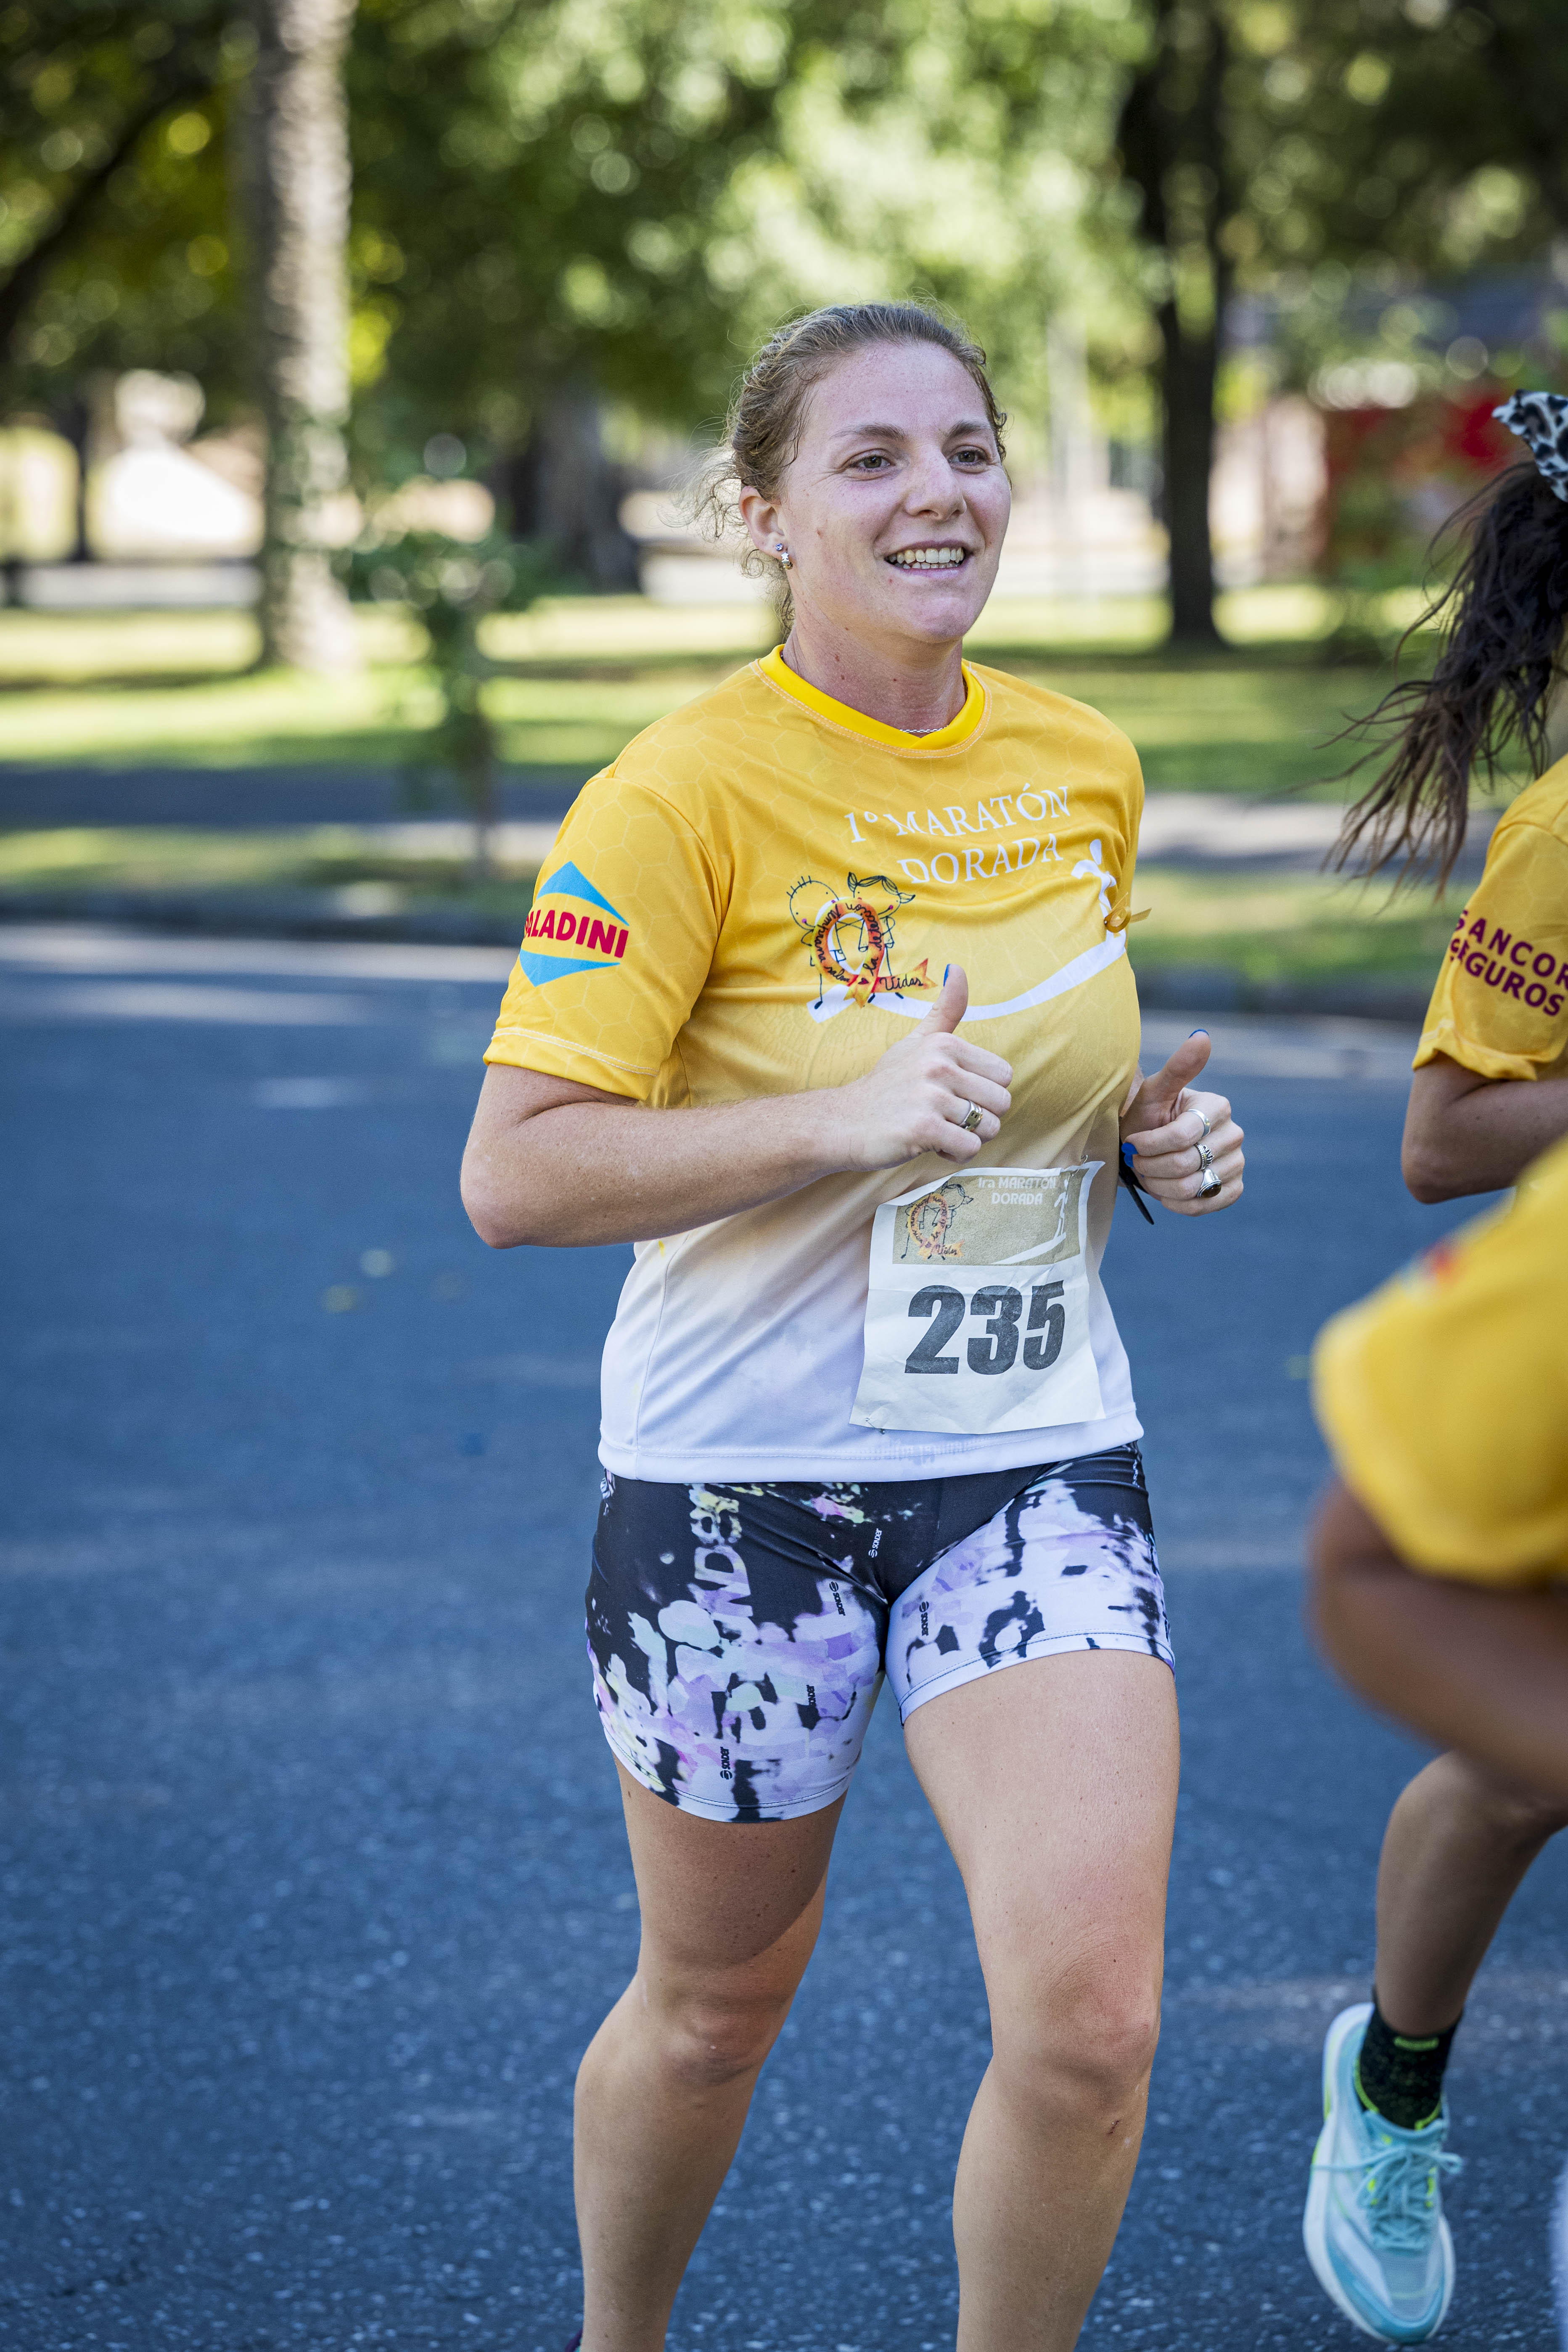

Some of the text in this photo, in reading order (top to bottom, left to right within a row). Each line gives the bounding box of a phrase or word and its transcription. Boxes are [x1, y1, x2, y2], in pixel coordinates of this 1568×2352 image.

[883, 783, 1071, 836] MARATÓN
[896, 833, 1063, 884] DORADA
[992, 1192, 1043, 1205] DORADA
[904, 1280, 1065, 1375] 235
